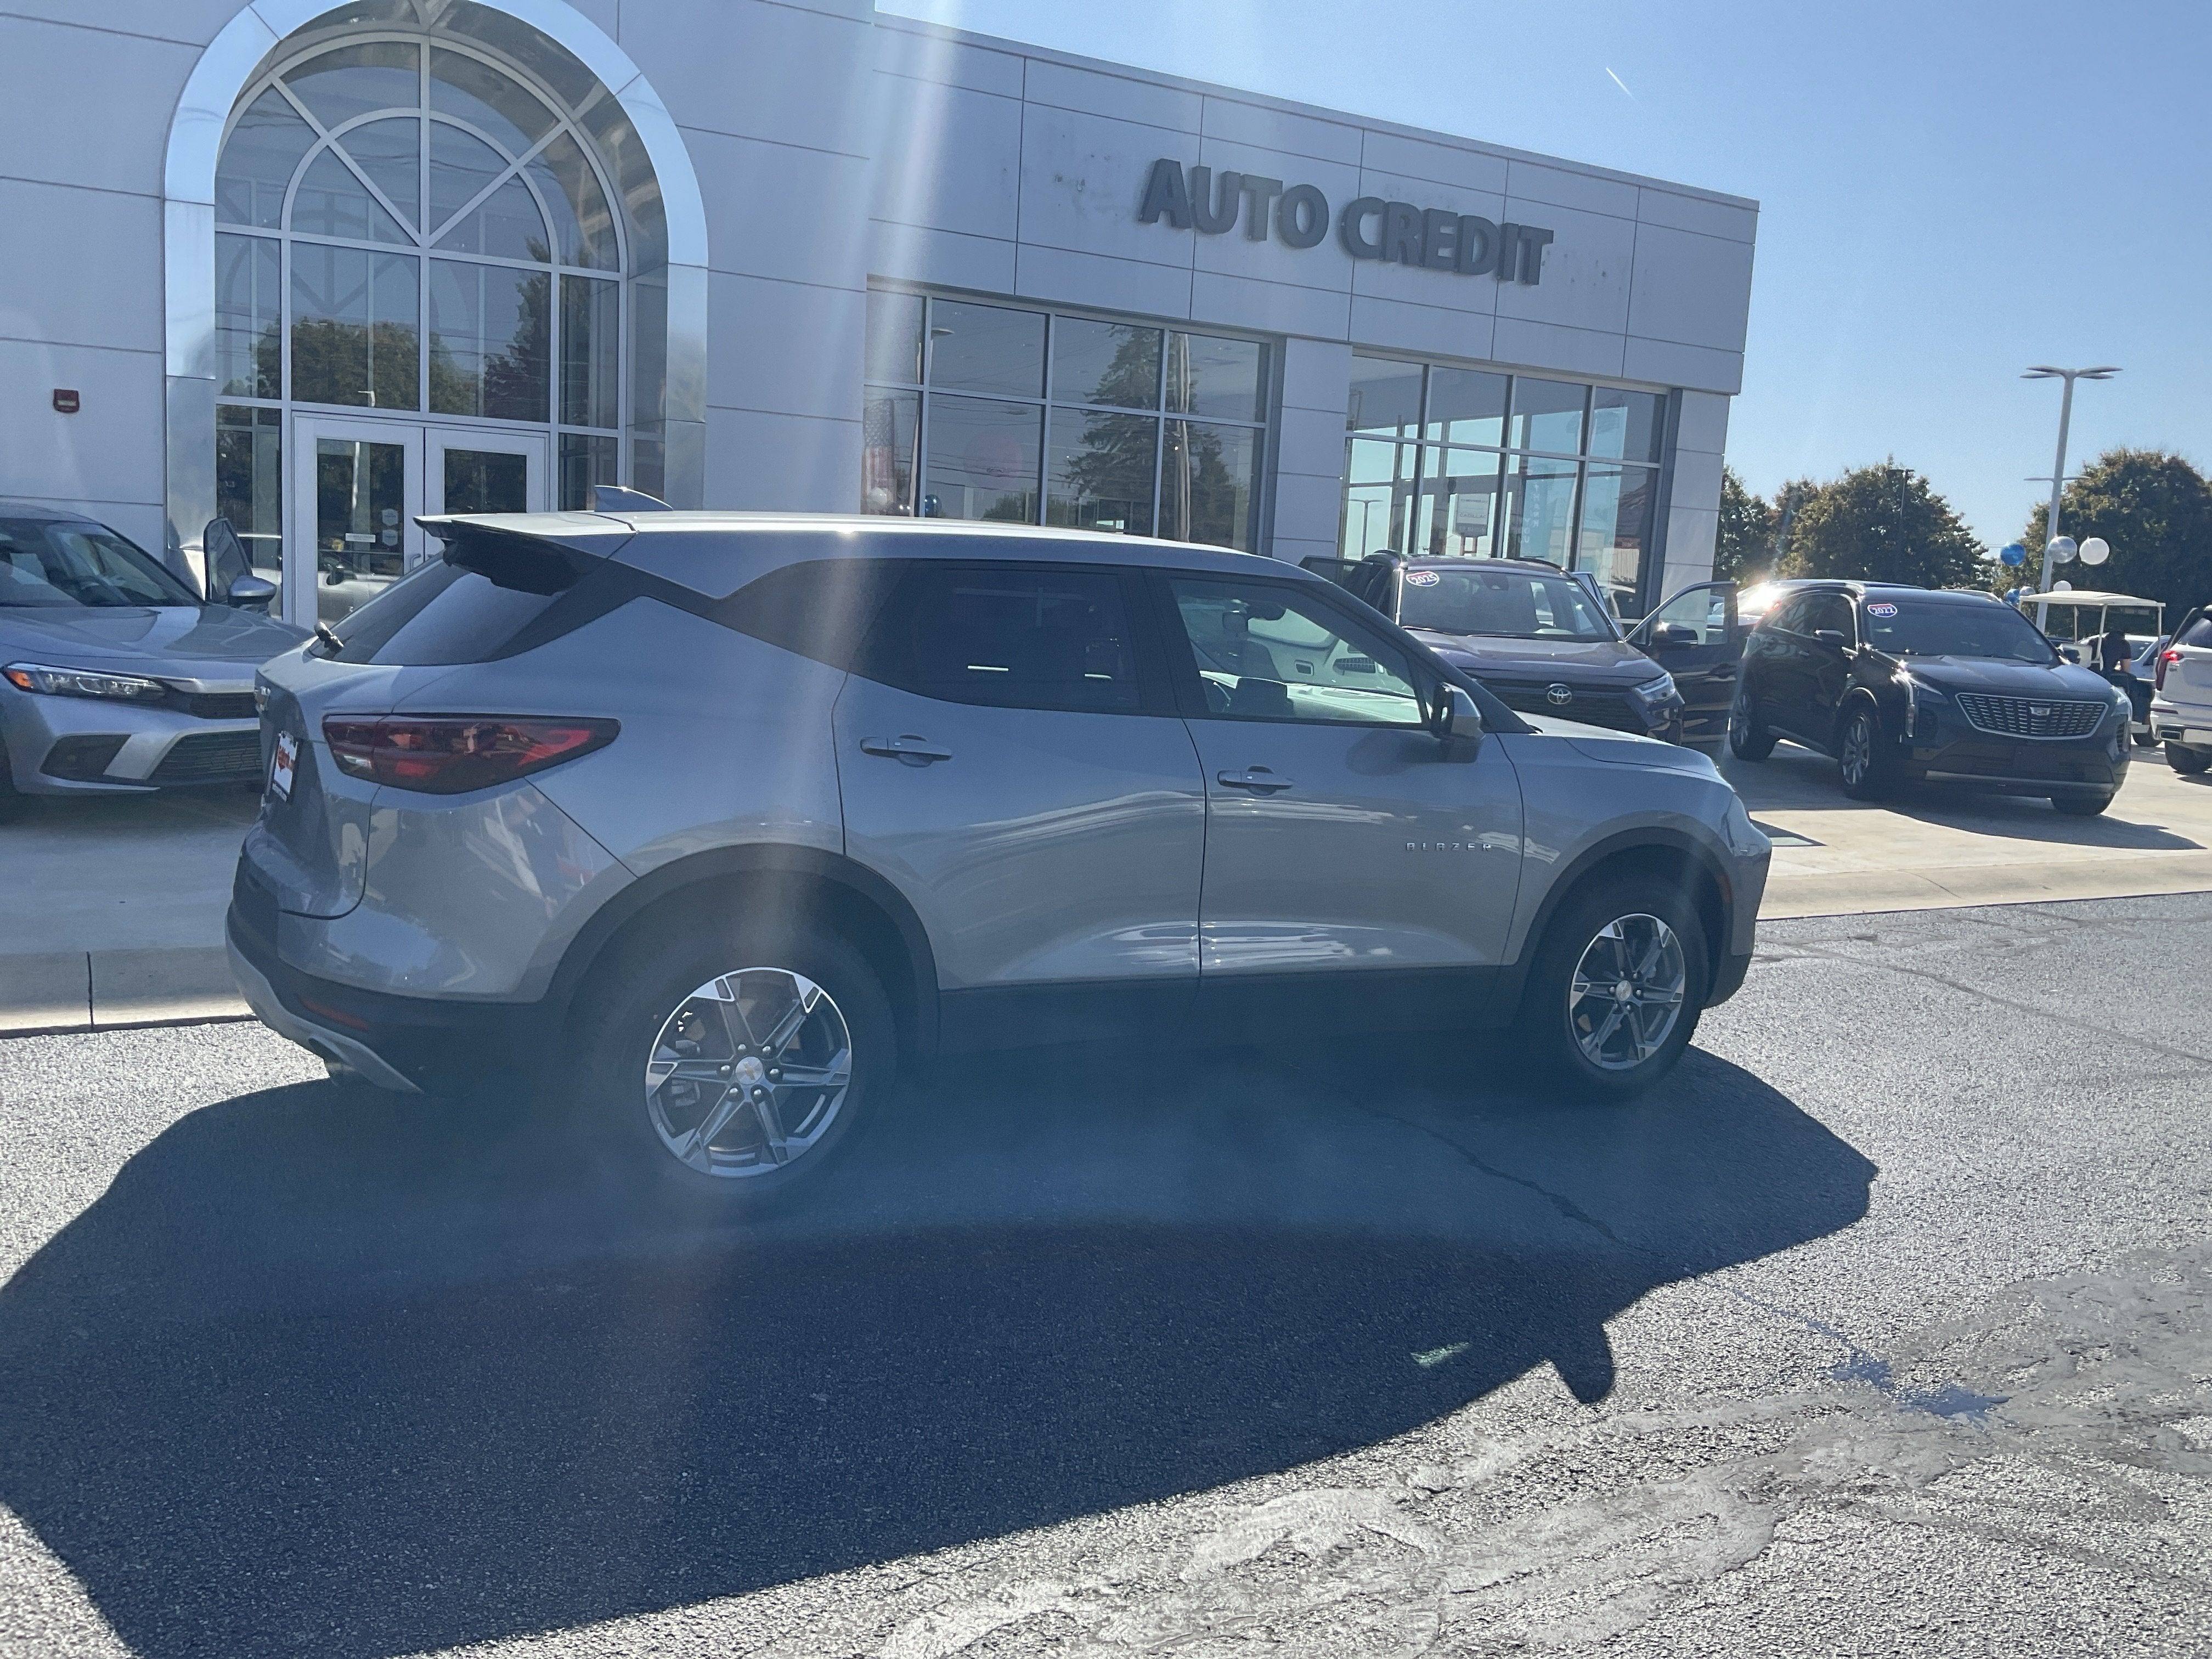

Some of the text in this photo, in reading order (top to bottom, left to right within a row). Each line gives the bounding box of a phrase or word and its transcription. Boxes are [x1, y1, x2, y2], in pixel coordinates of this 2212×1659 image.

[1139, 158, 1554, 285] AUTO CREDIT
[1411, 574, 1437, 585] 2025
[1406, 842, 1492, 851] BLAZER
